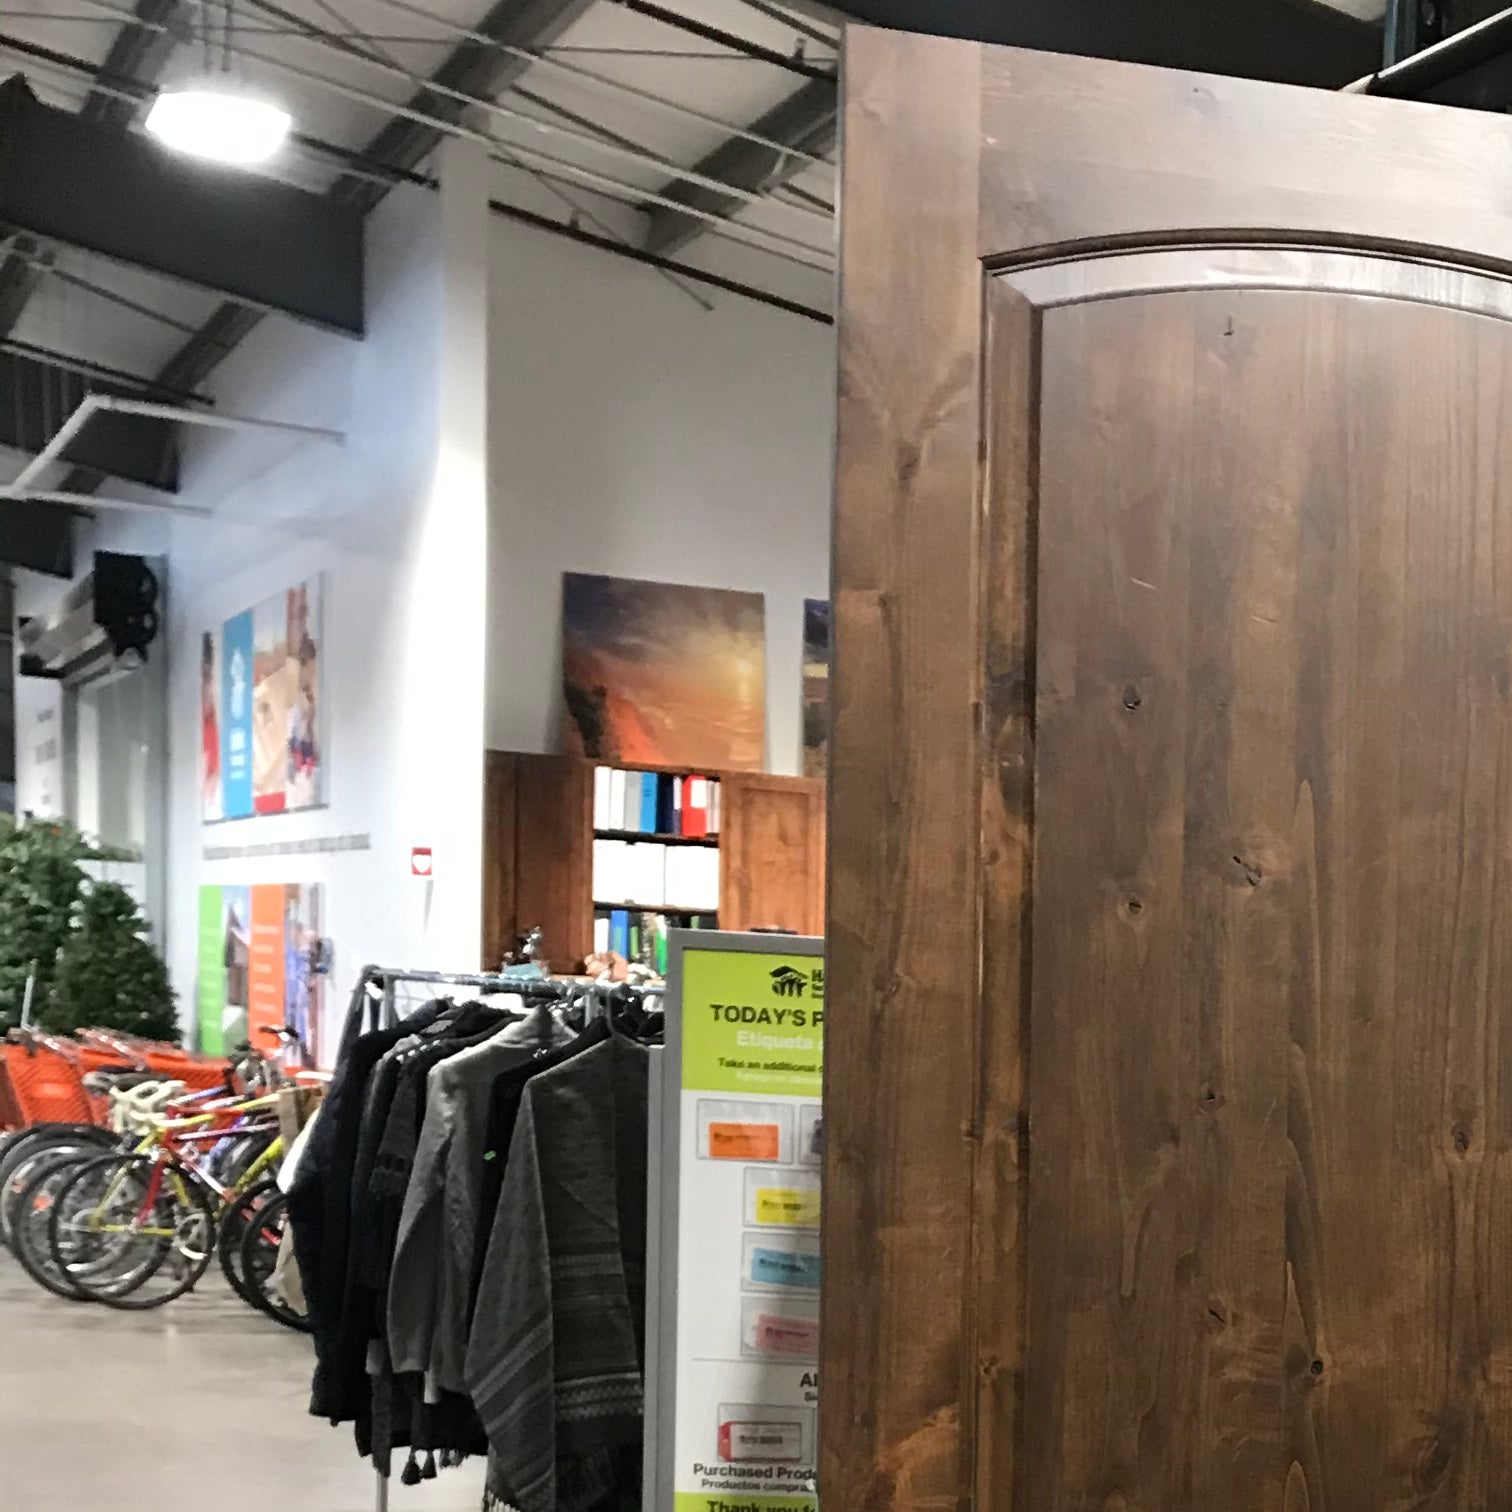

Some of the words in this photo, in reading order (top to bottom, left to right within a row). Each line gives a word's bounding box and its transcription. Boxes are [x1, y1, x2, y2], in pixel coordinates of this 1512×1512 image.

[709, 1004, 807, 1027] TODAY'S
[736, 1030, 813, 1050] Etiqueta
[763, 1061, 816, 1073] additional
[693, 1463, 774, 1479] Purchased
[701, 1478, 761, 1491] Productos
